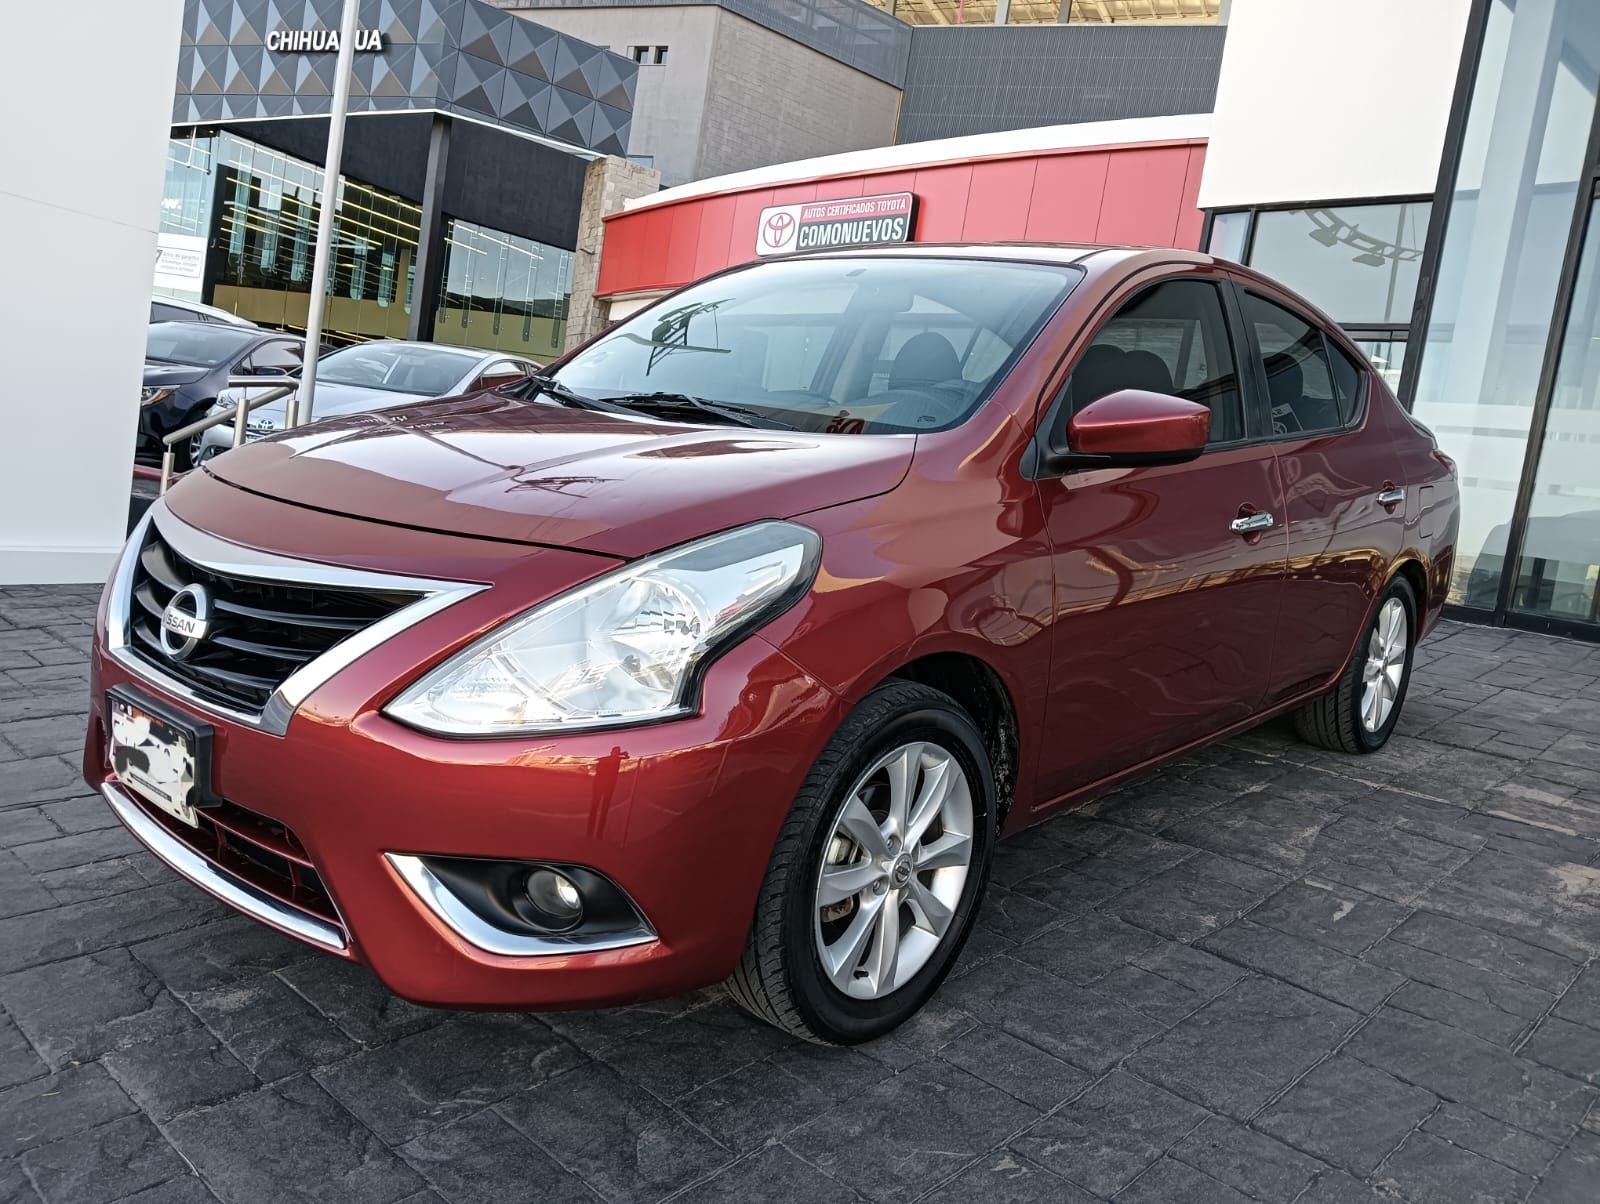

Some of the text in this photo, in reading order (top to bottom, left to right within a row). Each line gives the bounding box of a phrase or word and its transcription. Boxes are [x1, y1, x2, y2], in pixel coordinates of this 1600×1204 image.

[267, 30, 382, 51] CHIHUAUA
[803, 199, 906, 218] AUTOS CERTIFICADOS TOYOTA
[800, 217, 903, 246] COMONUEVOS
[164, 612, 196, 634] ISSAN
